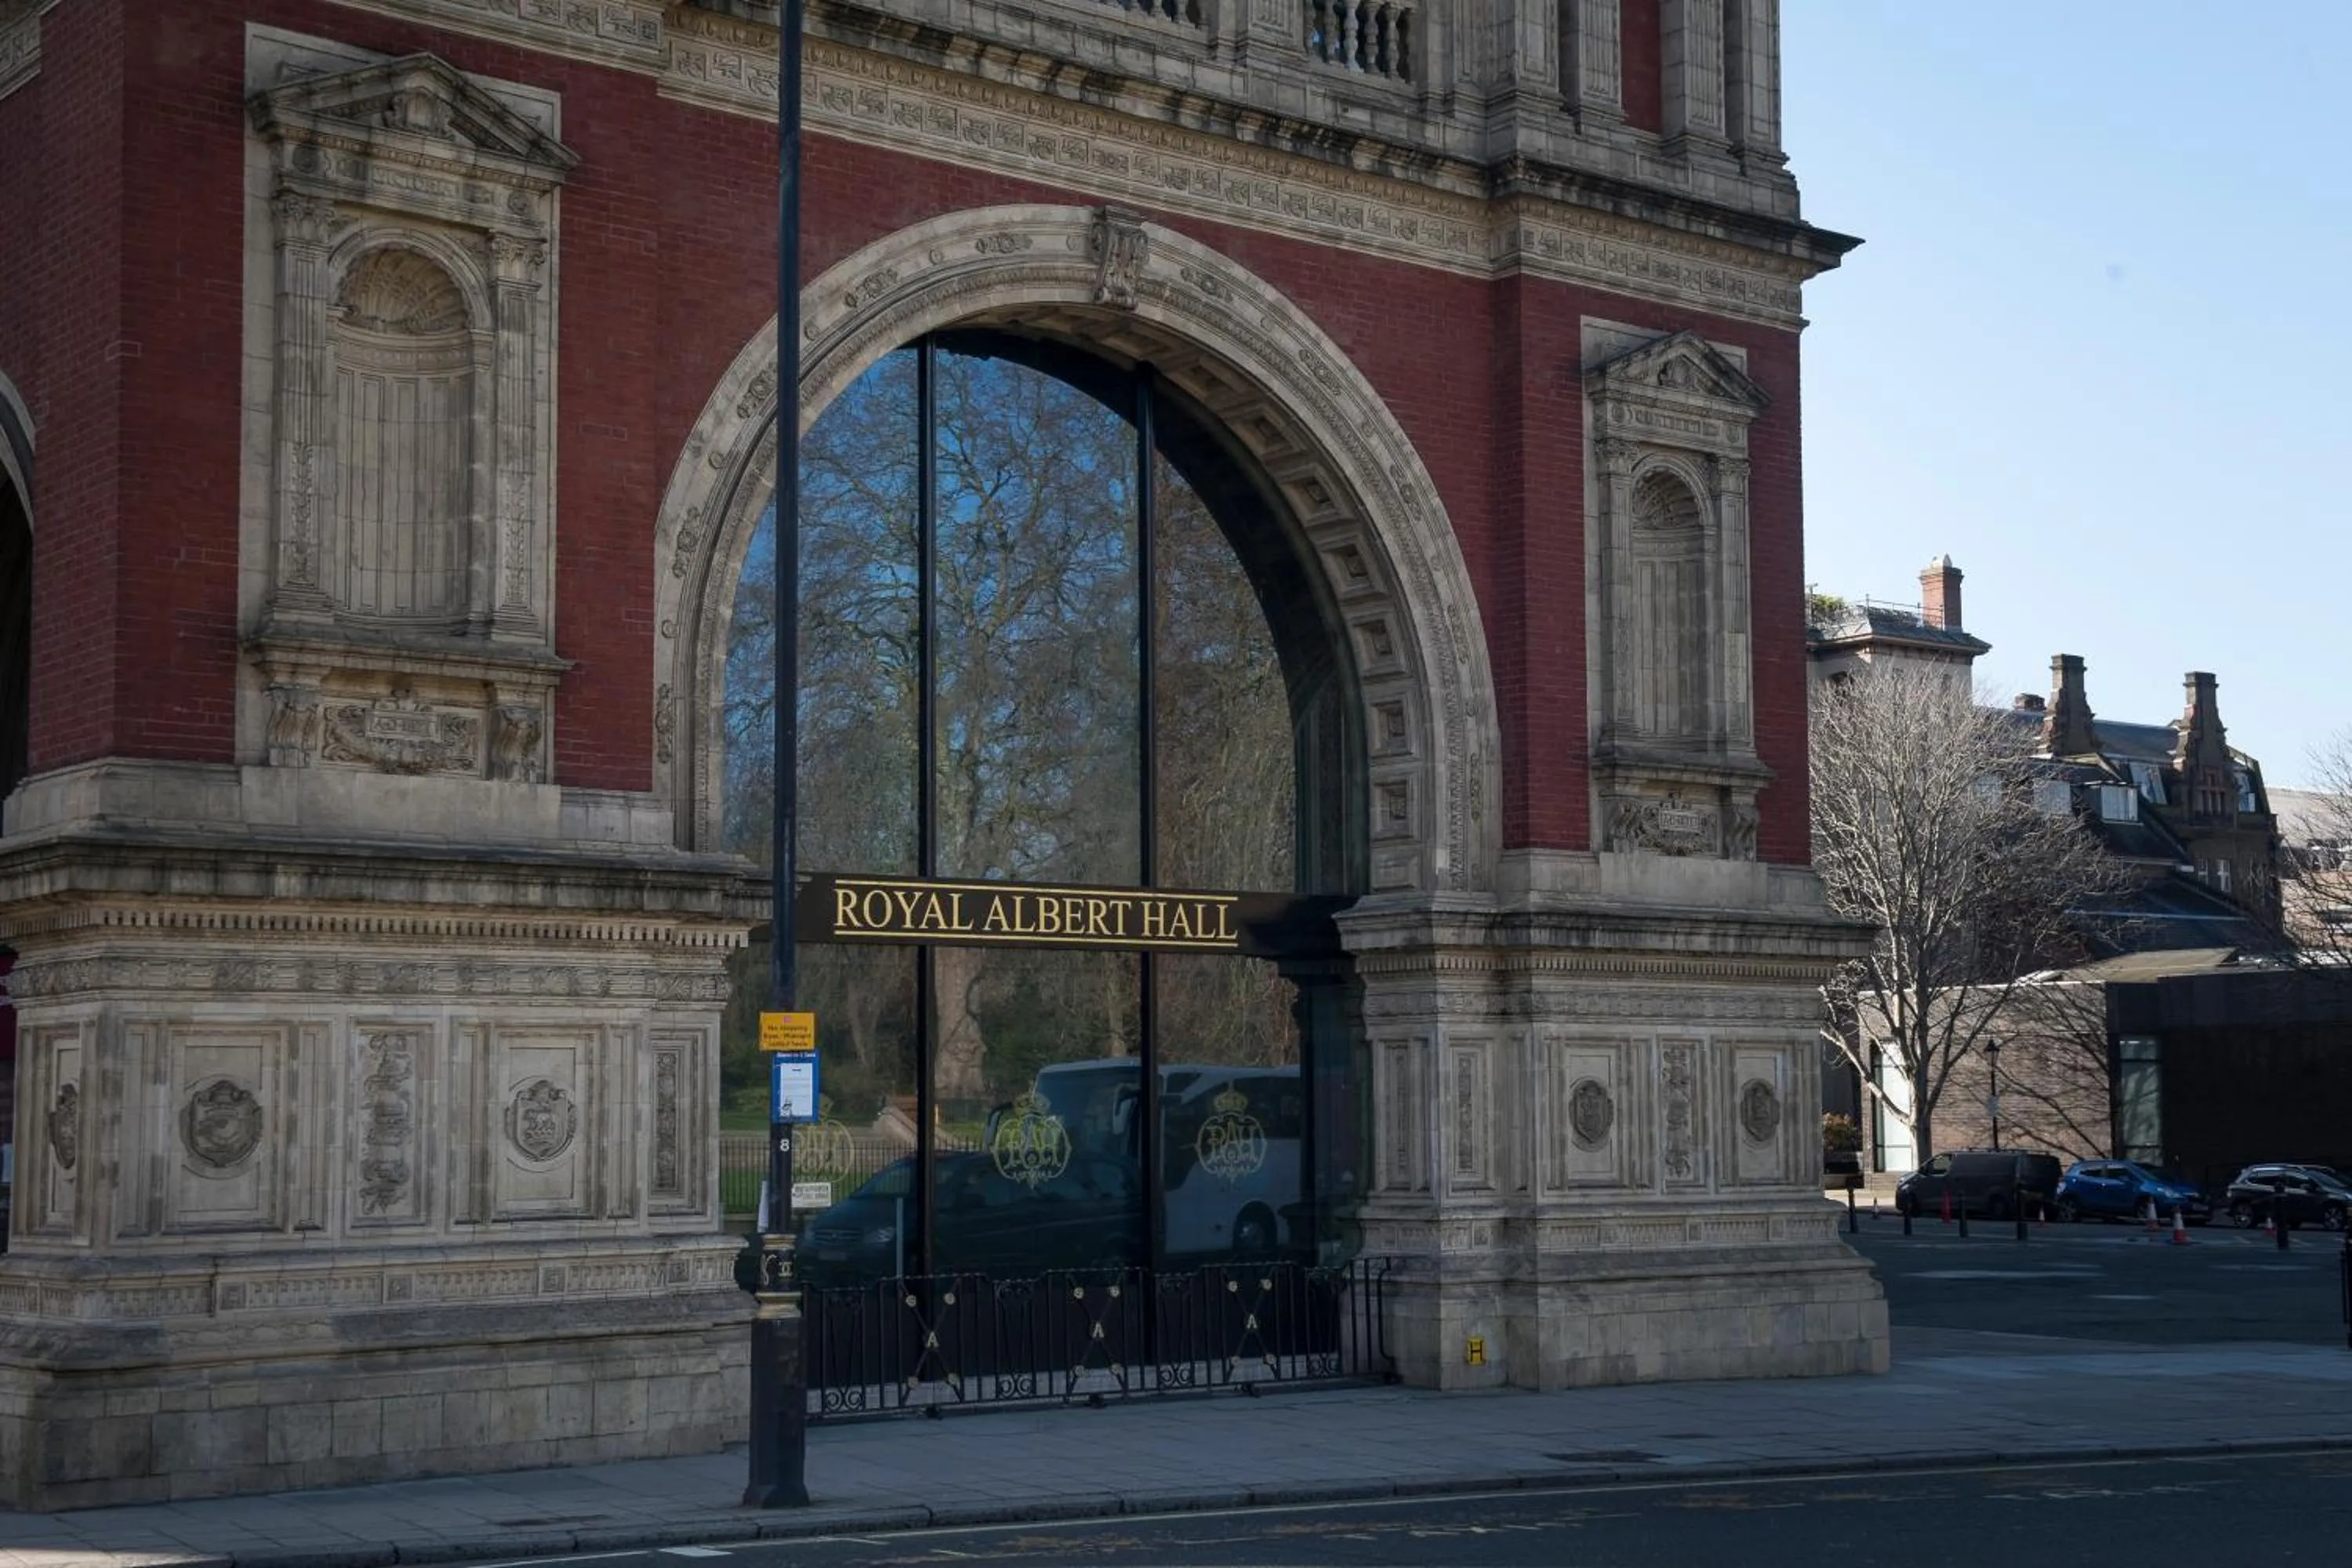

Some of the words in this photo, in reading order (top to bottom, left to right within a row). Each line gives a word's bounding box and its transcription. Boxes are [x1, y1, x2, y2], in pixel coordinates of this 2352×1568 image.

[834, 888, 974, 931] ROYAL
[983, 895, 1132, 936] ALBERT
[1142, 901, 1239, 940] HALL
[780, 1138, 790, 1152] 8
[1469, 1340, 1483, 1363] H
